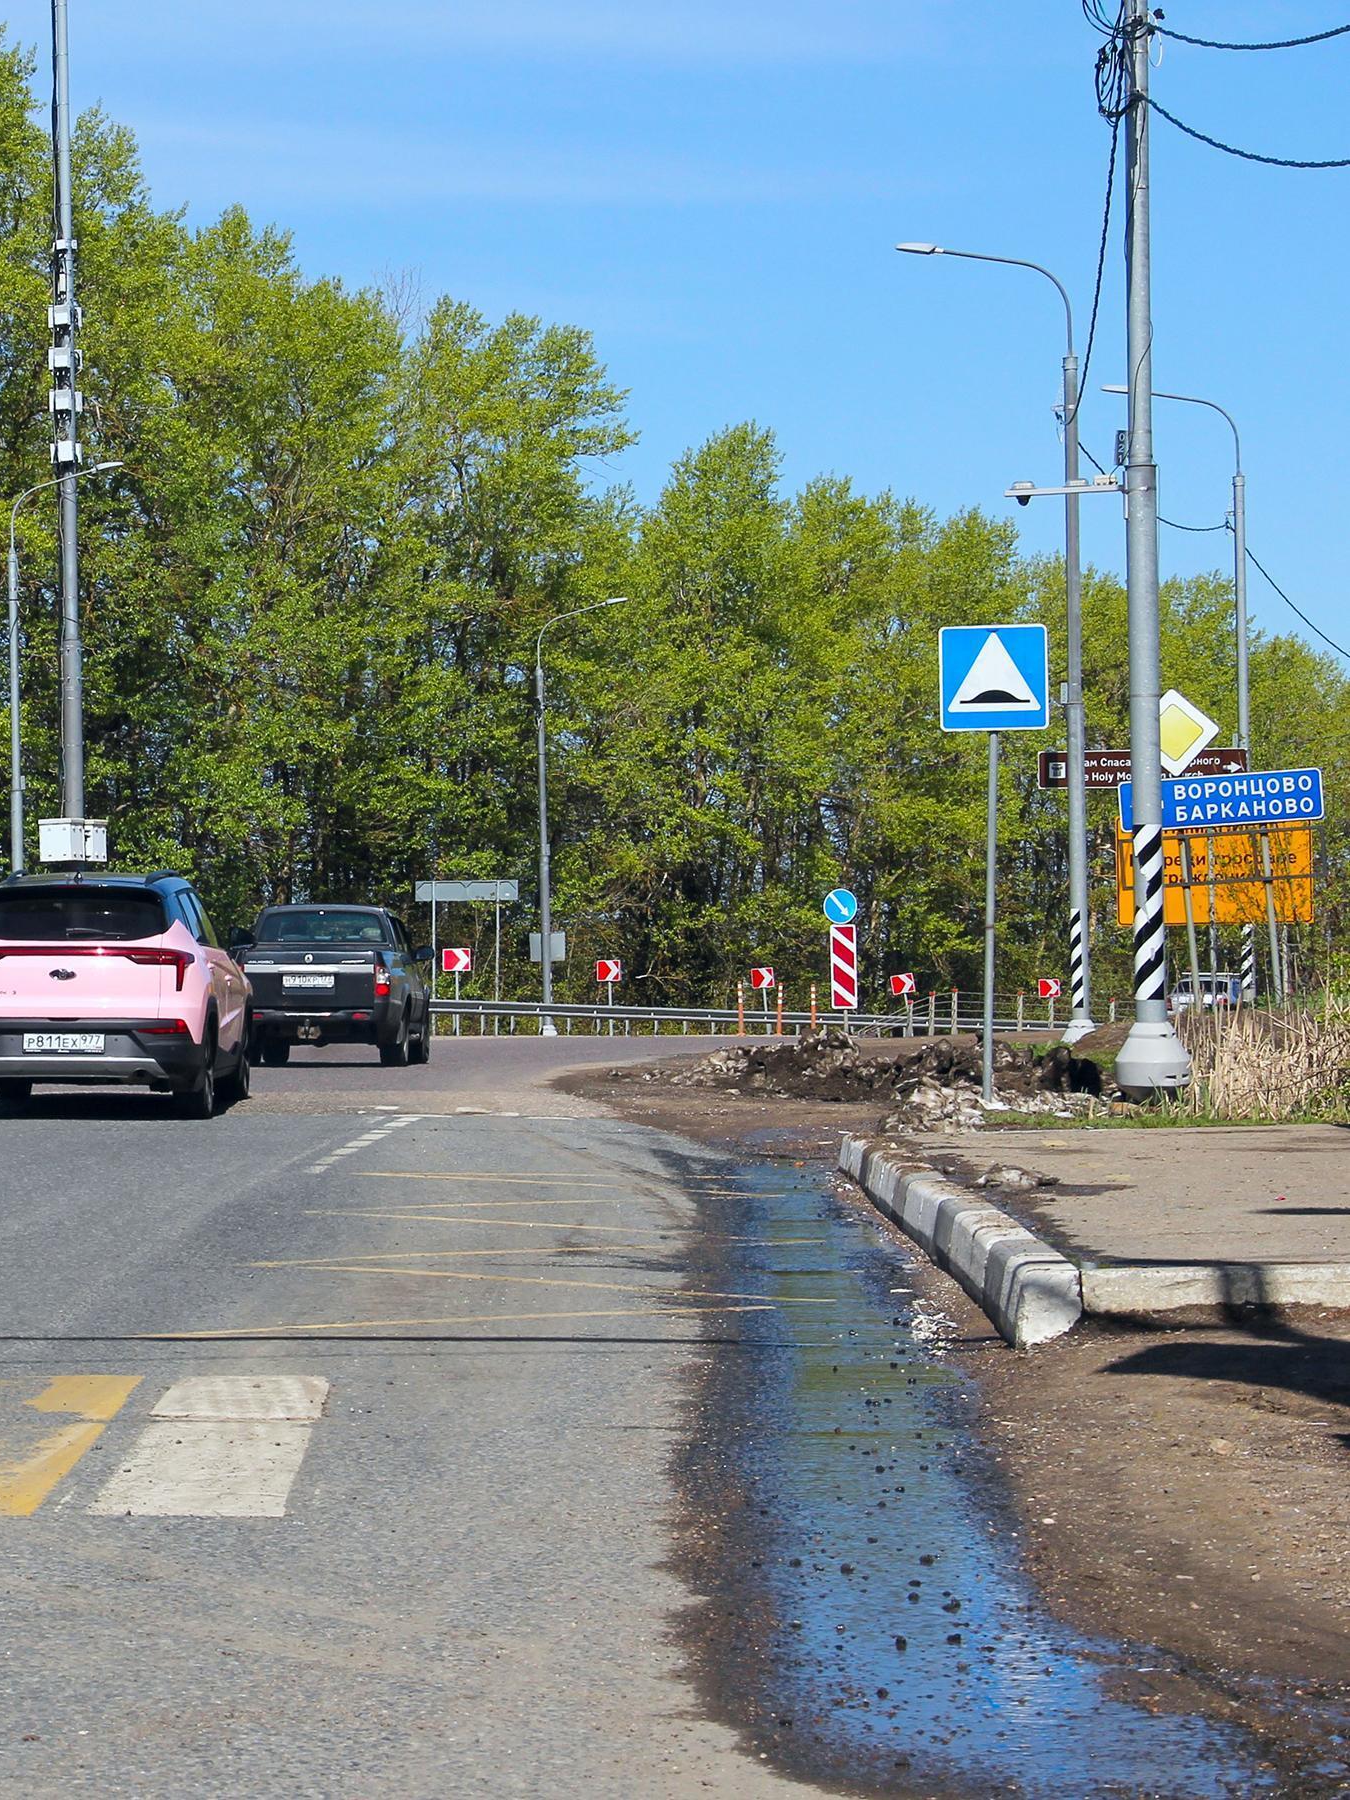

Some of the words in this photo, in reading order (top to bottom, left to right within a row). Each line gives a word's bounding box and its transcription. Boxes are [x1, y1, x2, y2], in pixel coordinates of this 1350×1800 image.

[1092, 769, 1113, 783] Holy
[1174, 775, 1313, 801] ВОРОНЦОВО
[1175, 796, 1314, 822] БАРКАНОВО
[81, 1035, 101, 1045] 977
